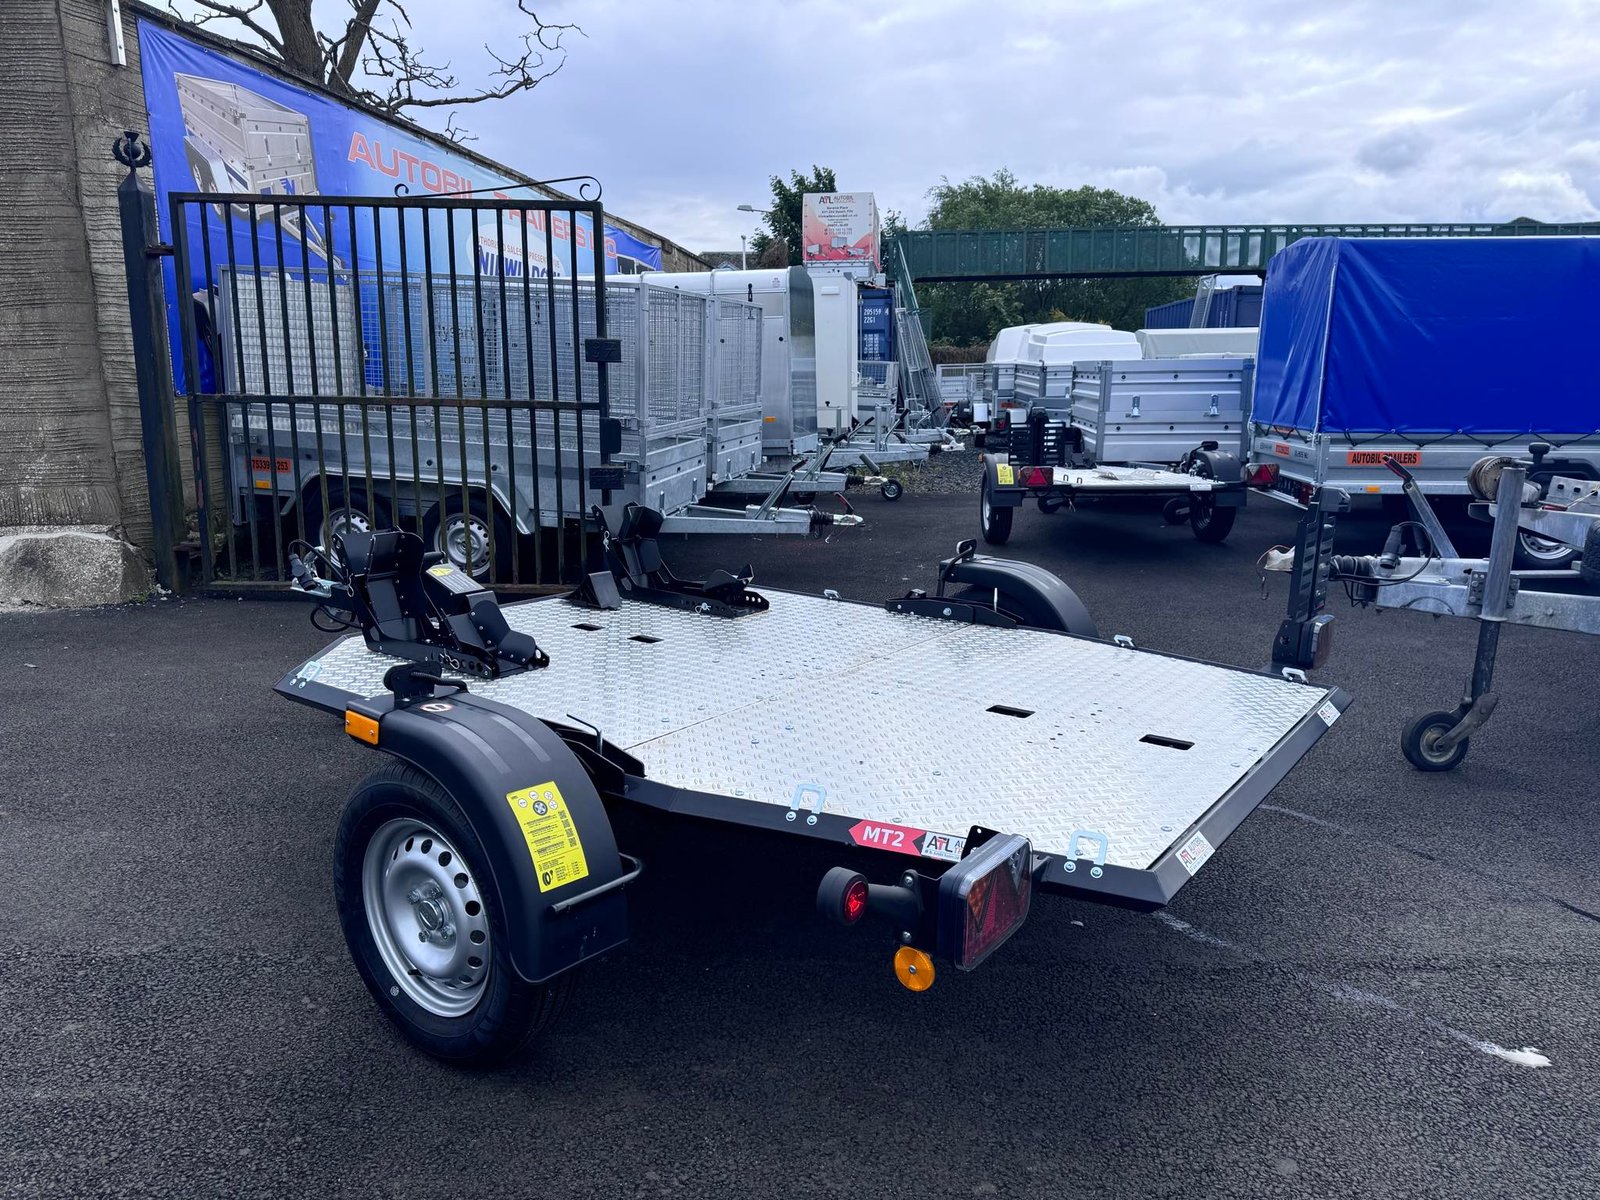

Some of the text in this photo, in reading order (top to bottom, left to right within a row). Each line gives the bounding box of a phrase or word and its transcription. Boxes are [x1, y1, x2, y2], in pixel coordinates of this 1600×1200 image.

[819, 195, 833, 204] ATL
[1351, 453, 1382, 464] AUTOBIL
[862, 825, 905, 847] MT2
[926, 835, 953, 853] ATL
